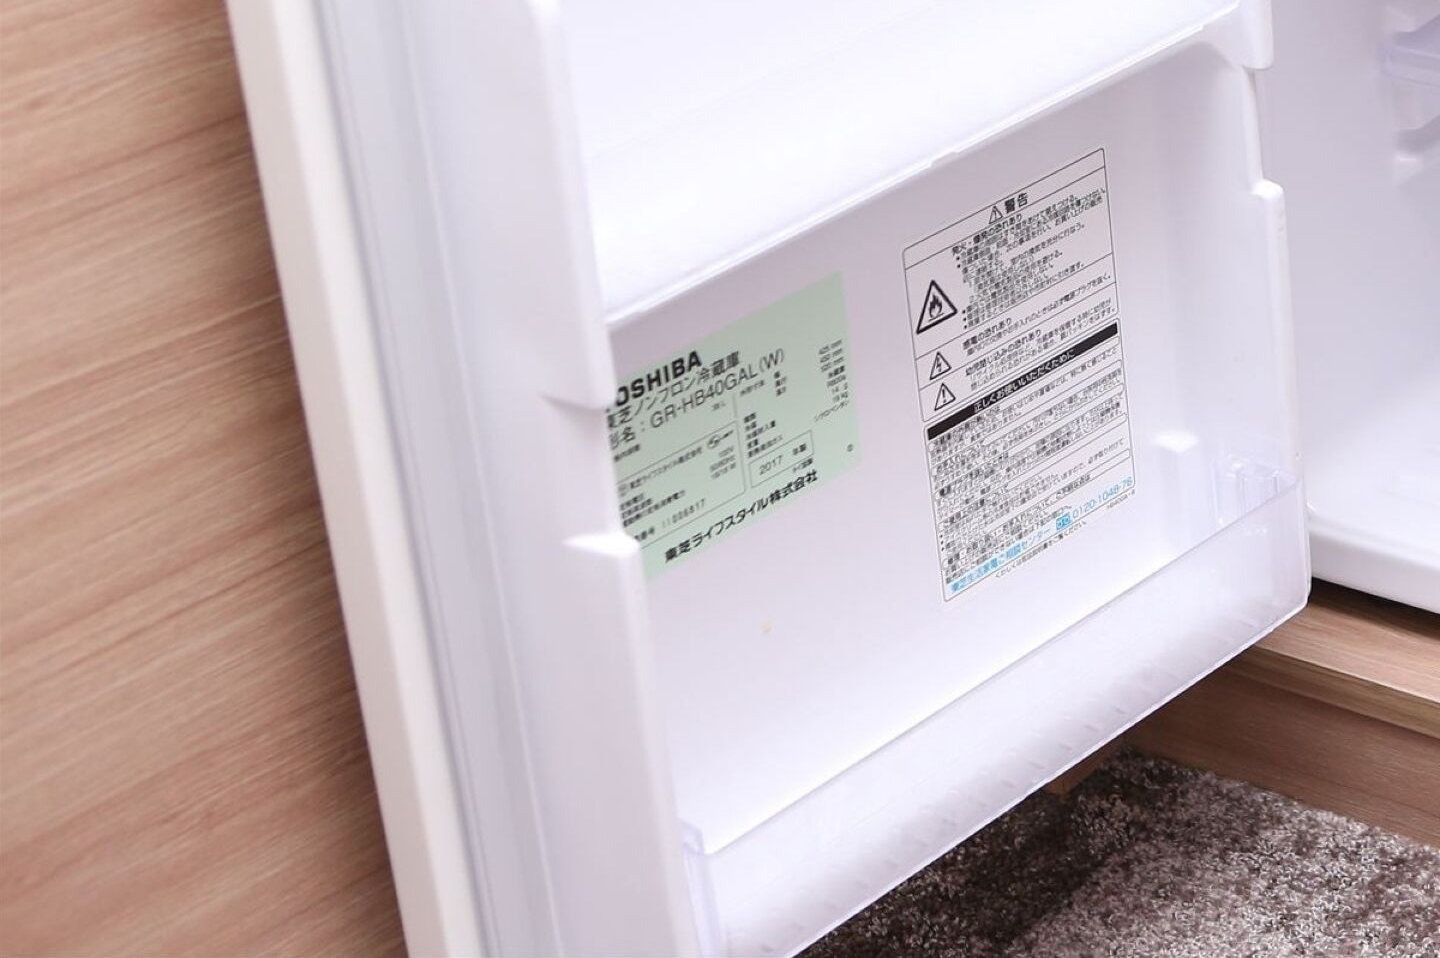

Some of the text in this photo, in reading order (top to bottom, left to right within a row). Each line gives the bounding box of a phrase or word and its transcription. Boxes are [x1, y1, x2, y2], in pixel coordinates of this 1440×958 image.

[1004, 193, 1029, 214] 警告
[606, 350, 702, 412] OSHIBA
[650, 348, 786, 429] GR-HB40GAL(W)
[974, 350, 1076, 412] 正しくお使いいただくために
[759, 454, 784, 477] 2017
[664, 469, 819, 563] 東芝ライフスタイル株式会社
